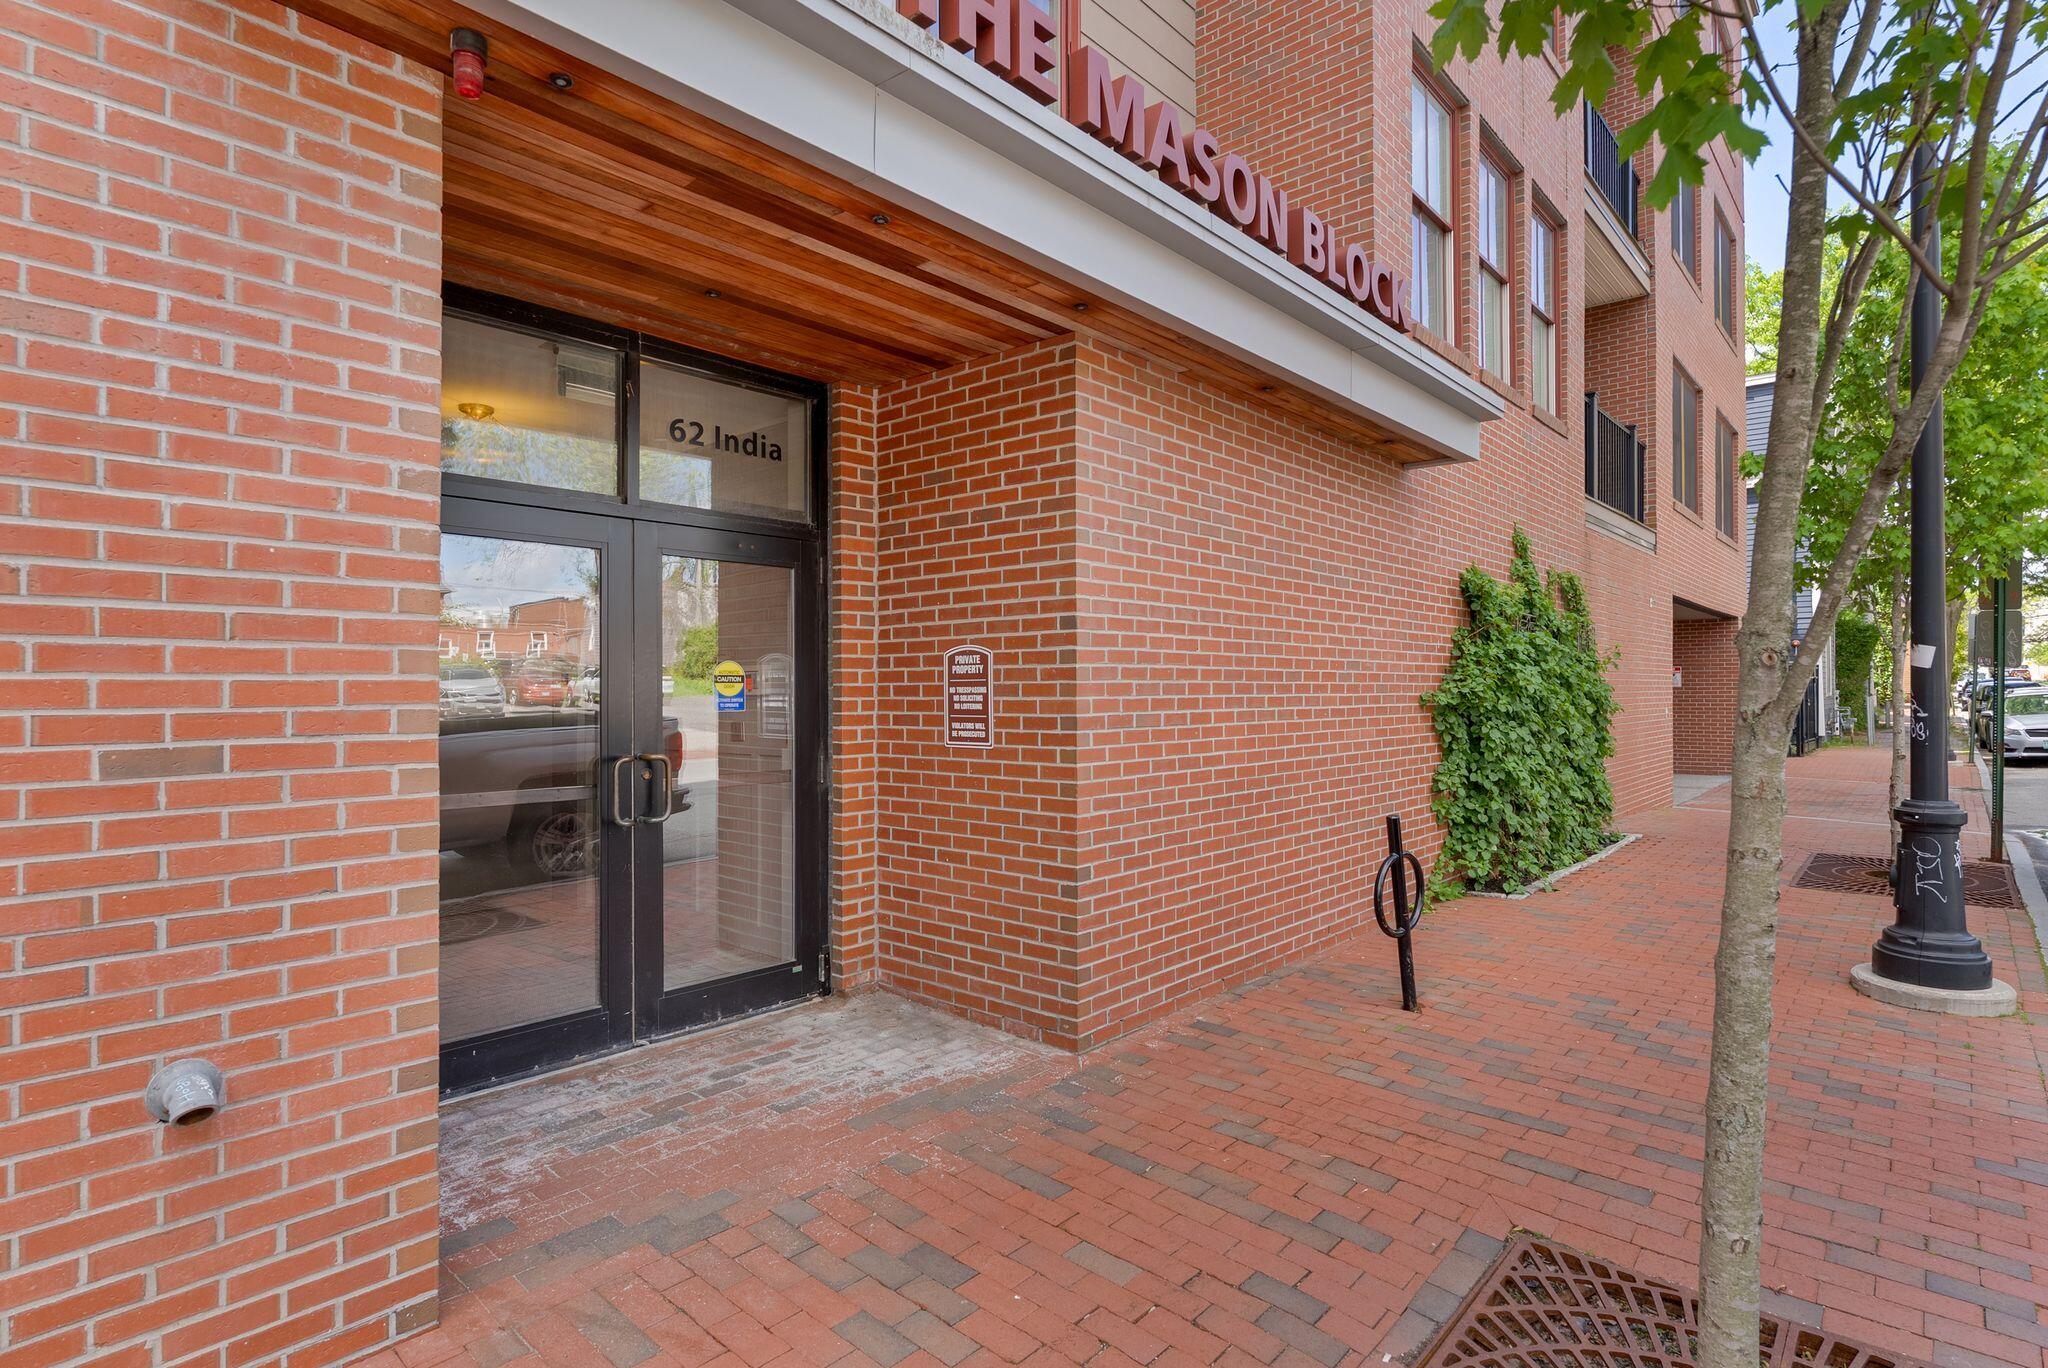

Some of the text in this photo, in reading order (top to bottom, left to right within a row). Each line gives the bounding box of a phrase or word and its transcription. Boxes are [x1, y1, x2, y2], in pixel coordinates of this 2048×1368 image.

[897, 0, 1411, 332] HE MASON BLOCK
[669, 418, 782, 462] 62 India
[952, 664, 984, 674] PROPERTY
[954, 654, 981, 665] PRIVATE
